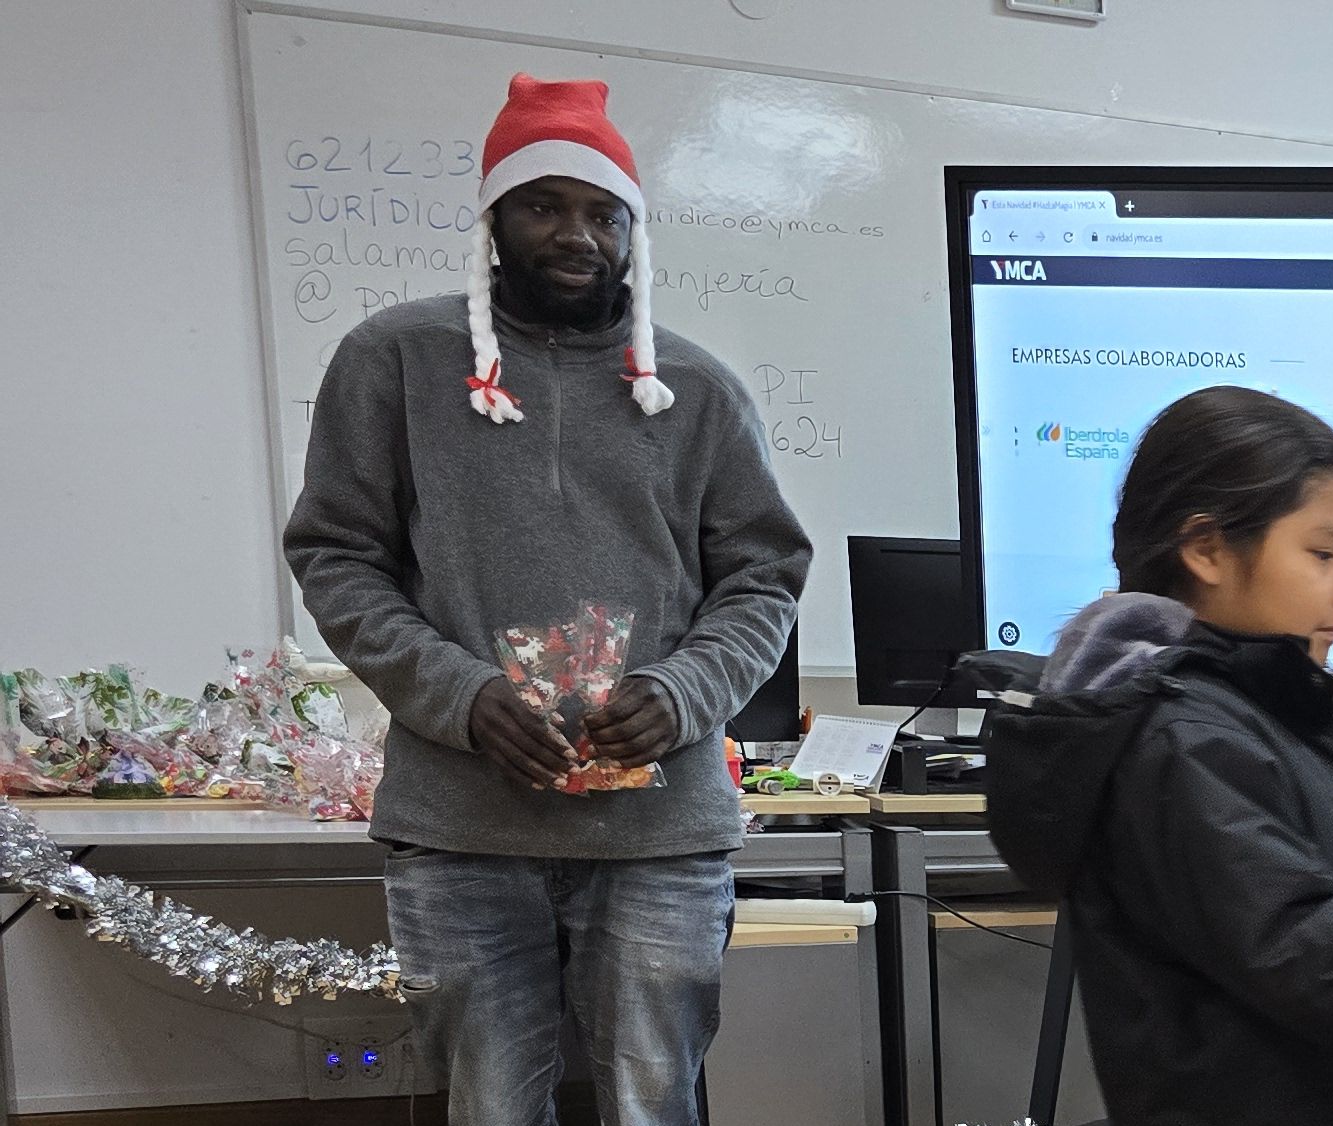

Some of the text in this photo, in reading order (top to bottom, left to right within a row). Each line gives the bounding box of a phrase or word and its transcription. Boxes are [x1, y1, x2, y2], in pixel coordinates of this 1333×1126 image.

[286, 137, 478, 179] 621233
[288, 184, 475, 232] JURÍDICO
[990, 260, 1047, 281] YMCA
[653, 265, 809, 312] anjería
[1012, 347, 1247, 368] EMPRESAS COLABORADORAS
[766, 416, 841, 457] 624
[1064, 426, 1130, 443] Iberdrola
[1066, 443, 1120, 461] España
